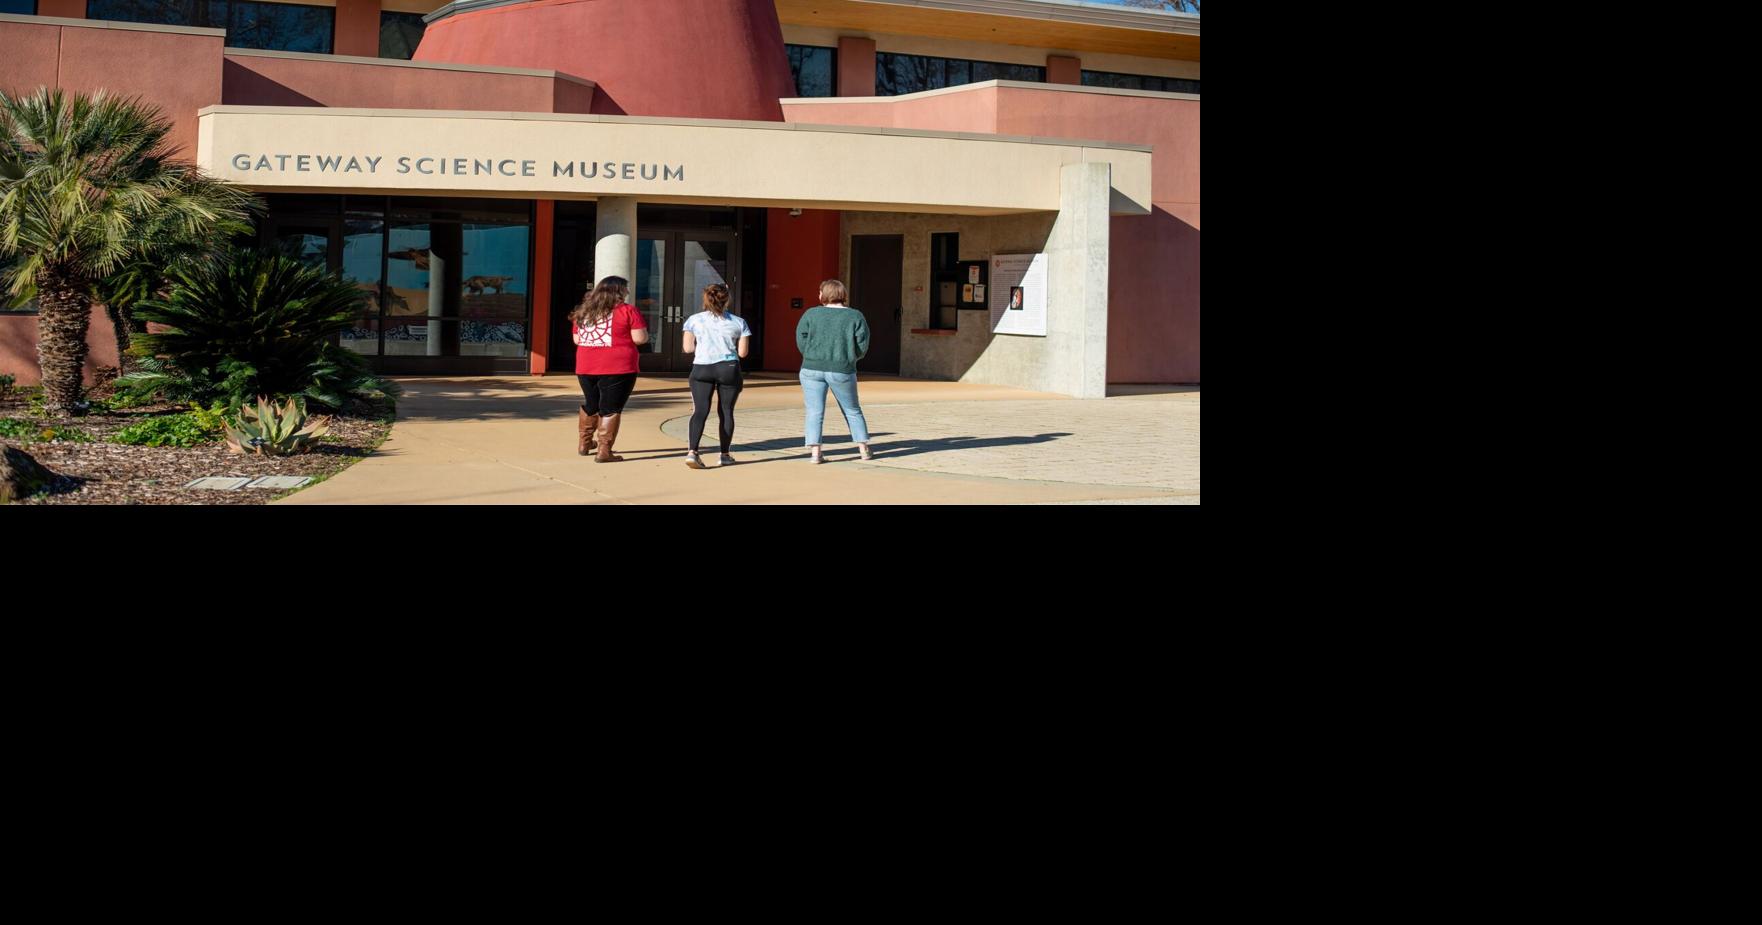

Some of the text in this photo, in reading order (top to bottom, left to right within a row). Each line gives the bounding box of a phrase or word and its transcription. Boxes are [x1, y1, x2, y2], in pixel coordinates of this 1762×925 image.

[231, 153, 684, 181] GATEWAY SCIENCE MUSEUM
